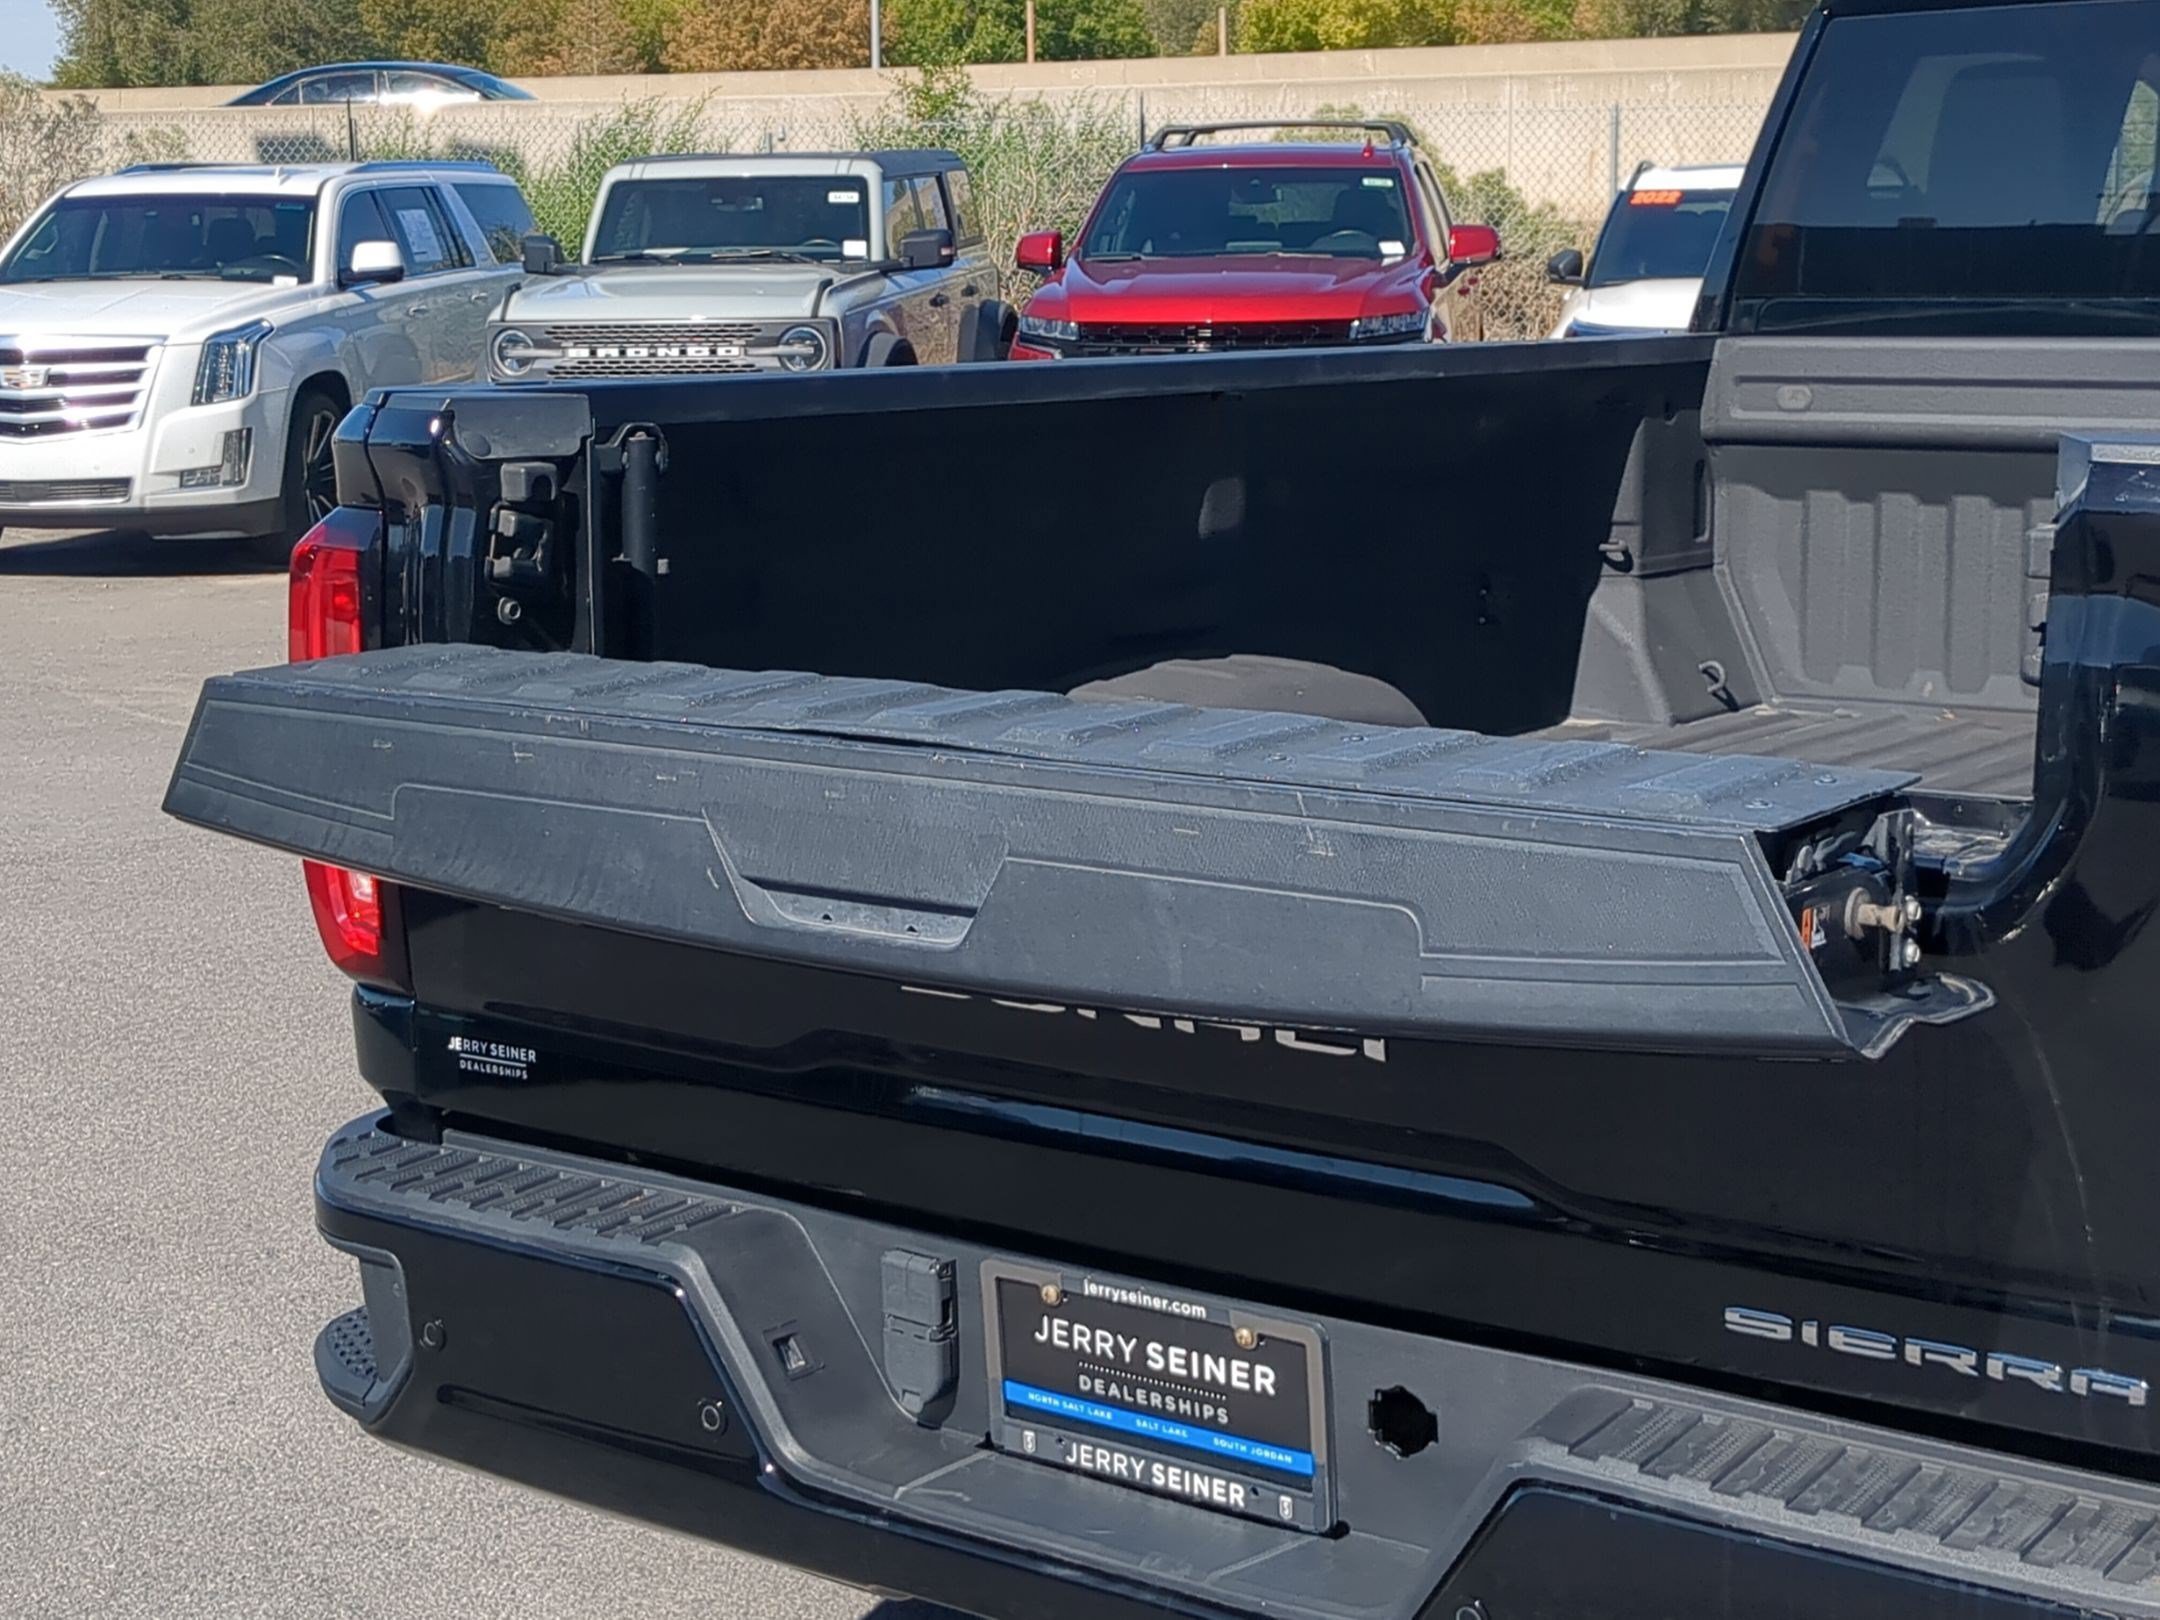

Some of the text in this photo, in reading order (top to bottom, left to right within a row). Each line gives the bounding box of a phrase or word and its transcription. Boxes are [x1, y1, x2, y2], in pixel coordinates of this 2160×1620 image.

[1630, 191, 1681, 204] 2022
[567, 346, 740, 358] BRONCO
[448, 1036, 537, 1063] JERRY SEINER
[460, 1060, 527, 1079] DEALERSHIPS
[1083, 1275, 1207, 1319] jerryseiner.com
[1034, 1314, 1277, 1396] JERRY SEINER
[1724, 1306, 2149, 1406] SIERRA
[1028, 1392, 1113, 1420] NORTH SALT LAKE
[1078, 1374, 1230, 1425] DEALERSHIPS
[1136, 1418, 1189, 1438] SALT LAKE
[1213, 1437, 1292, 1464] SOUTH JORDAN
[1066, 1442, 1246, 1507] JERRY SEINER
